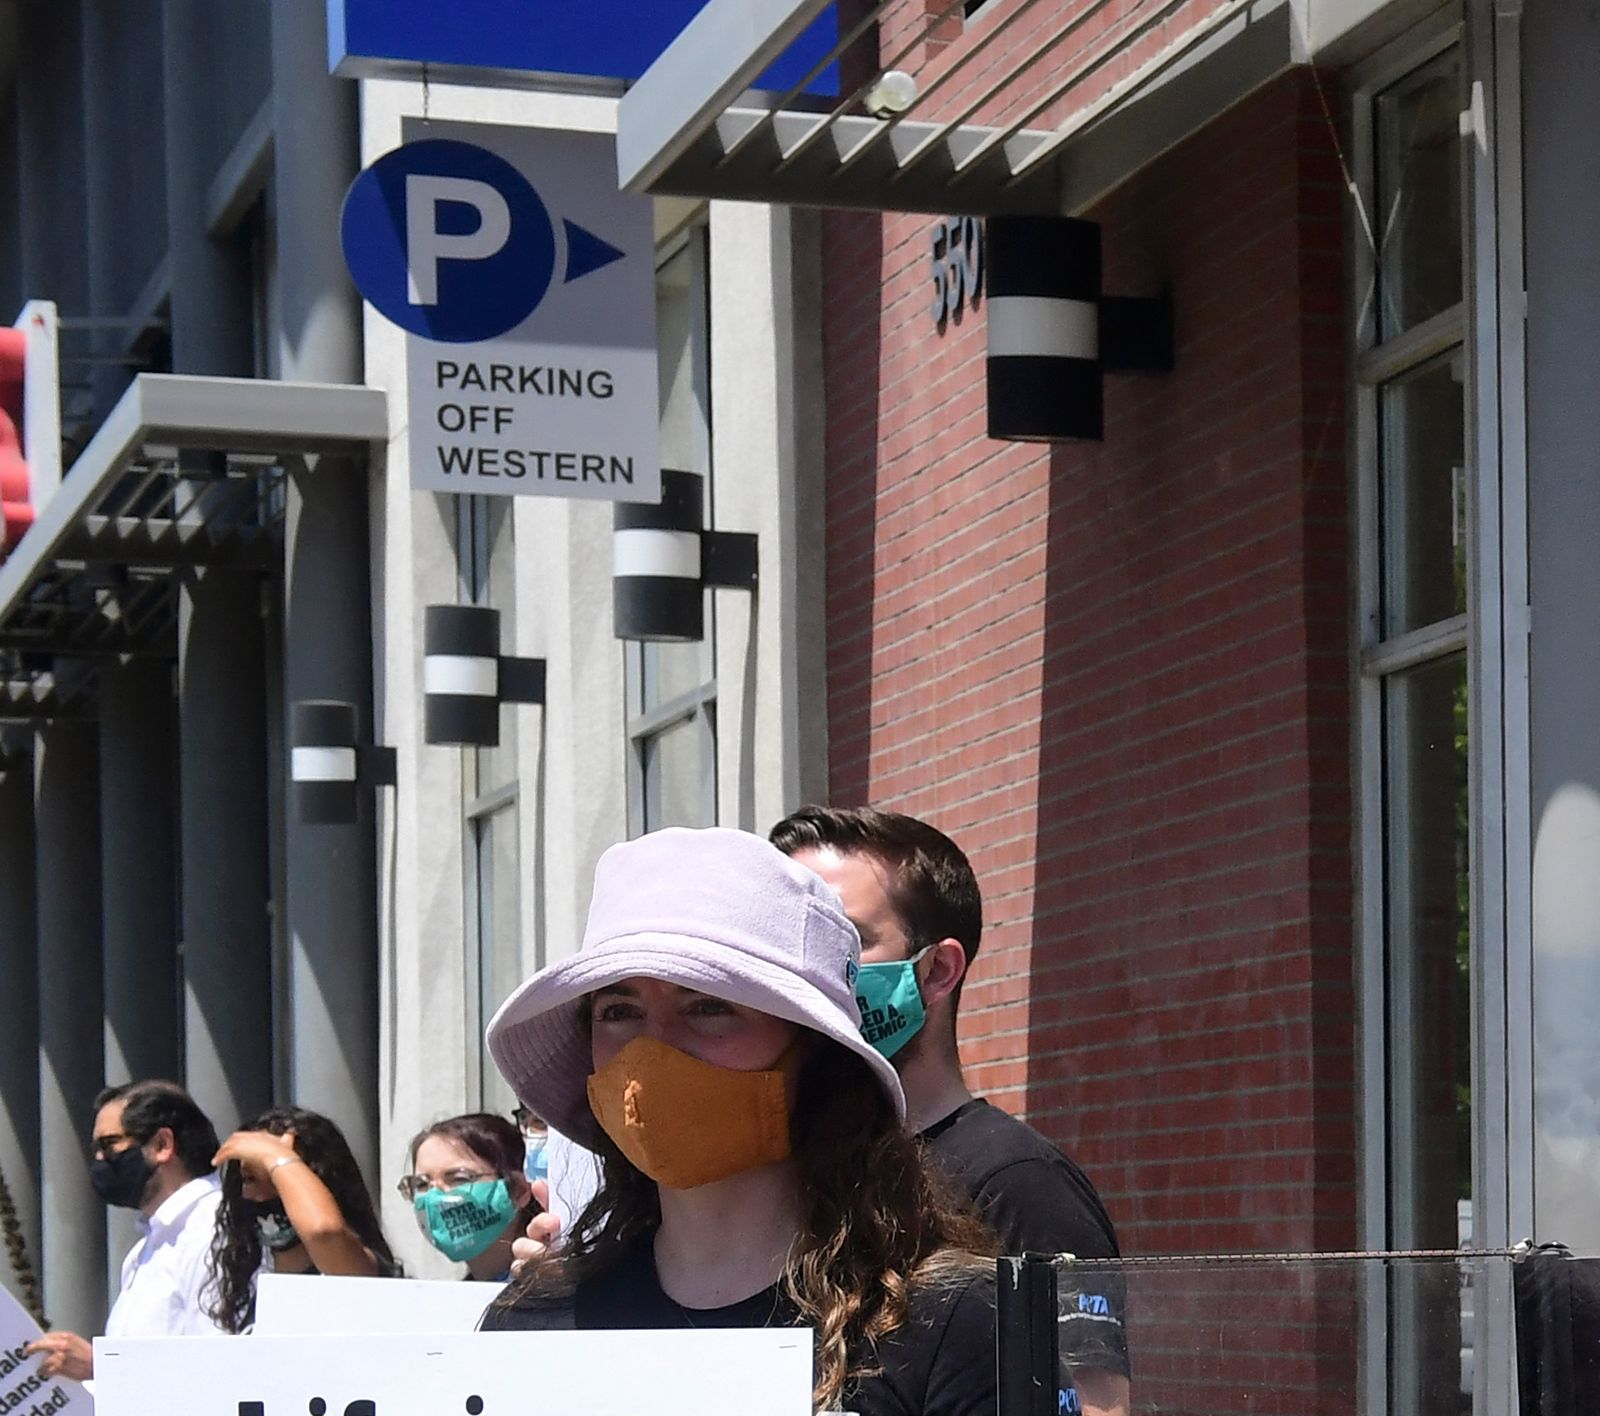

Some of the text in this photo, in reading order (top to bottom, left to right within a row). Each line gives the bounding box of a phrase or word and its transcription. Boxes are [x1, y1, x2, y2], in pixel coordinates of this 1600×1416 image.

[405, 173, 512, 306] P
[437, 360, 614, 399] PARKING
[436, 403, 514, 434] OFF
[437, 446, 634, 484] WESTERN
